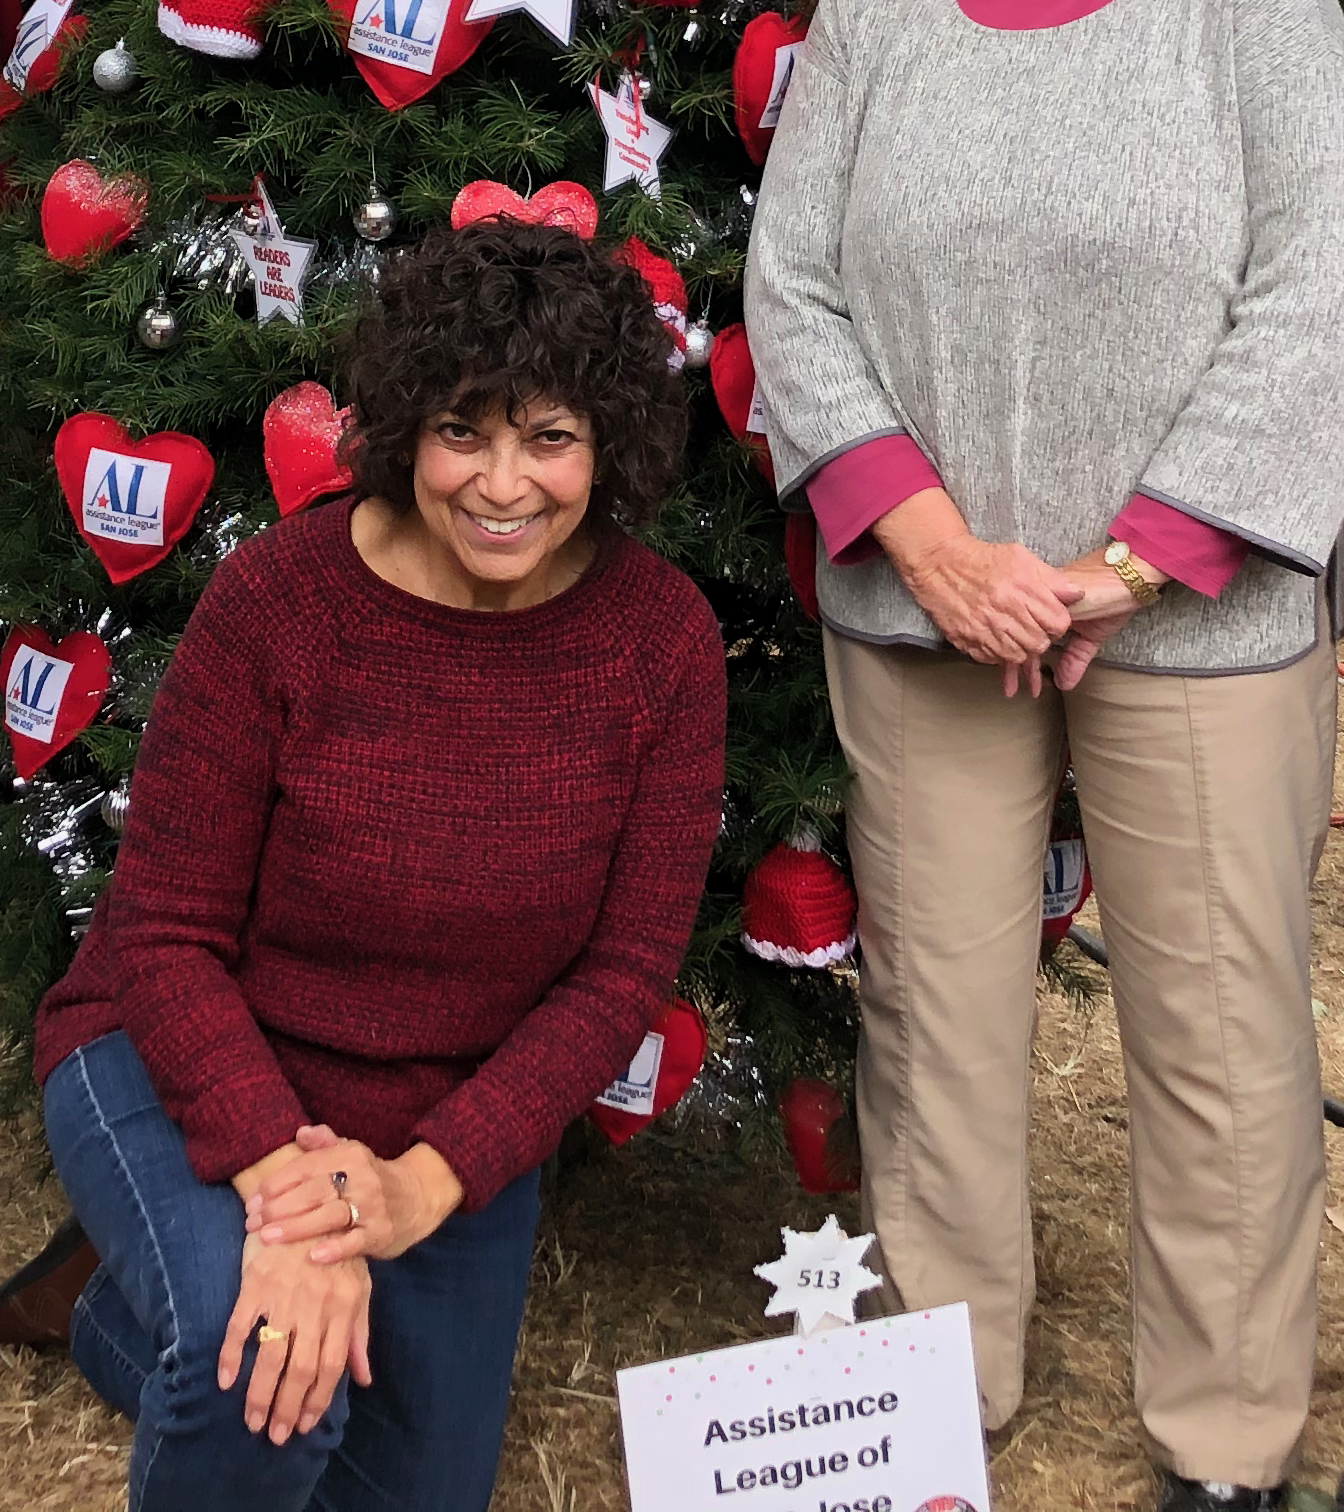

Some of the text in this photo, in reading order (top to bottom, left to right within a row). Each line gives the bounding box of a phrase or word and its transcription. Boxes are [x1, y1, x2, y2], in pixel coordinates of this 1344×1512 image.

[353, 27, 398, 47] assistance
[367, 43, 409, 62] SAN JOSE
[253, 245, 291, 267] READERS
[260, 280, 296, 302] LEADERS
[87, 459, 159, 519] AL
[86, 508, 126, 524] assistance
[101, 522, 139, 538] SAN JOSE
[8, 655, 57, 716] AL
[797, 1268, 841, 1289] 513
[704, 1390, 899, 1447] Assistance
[714, 1434, 892, 1496] League of
